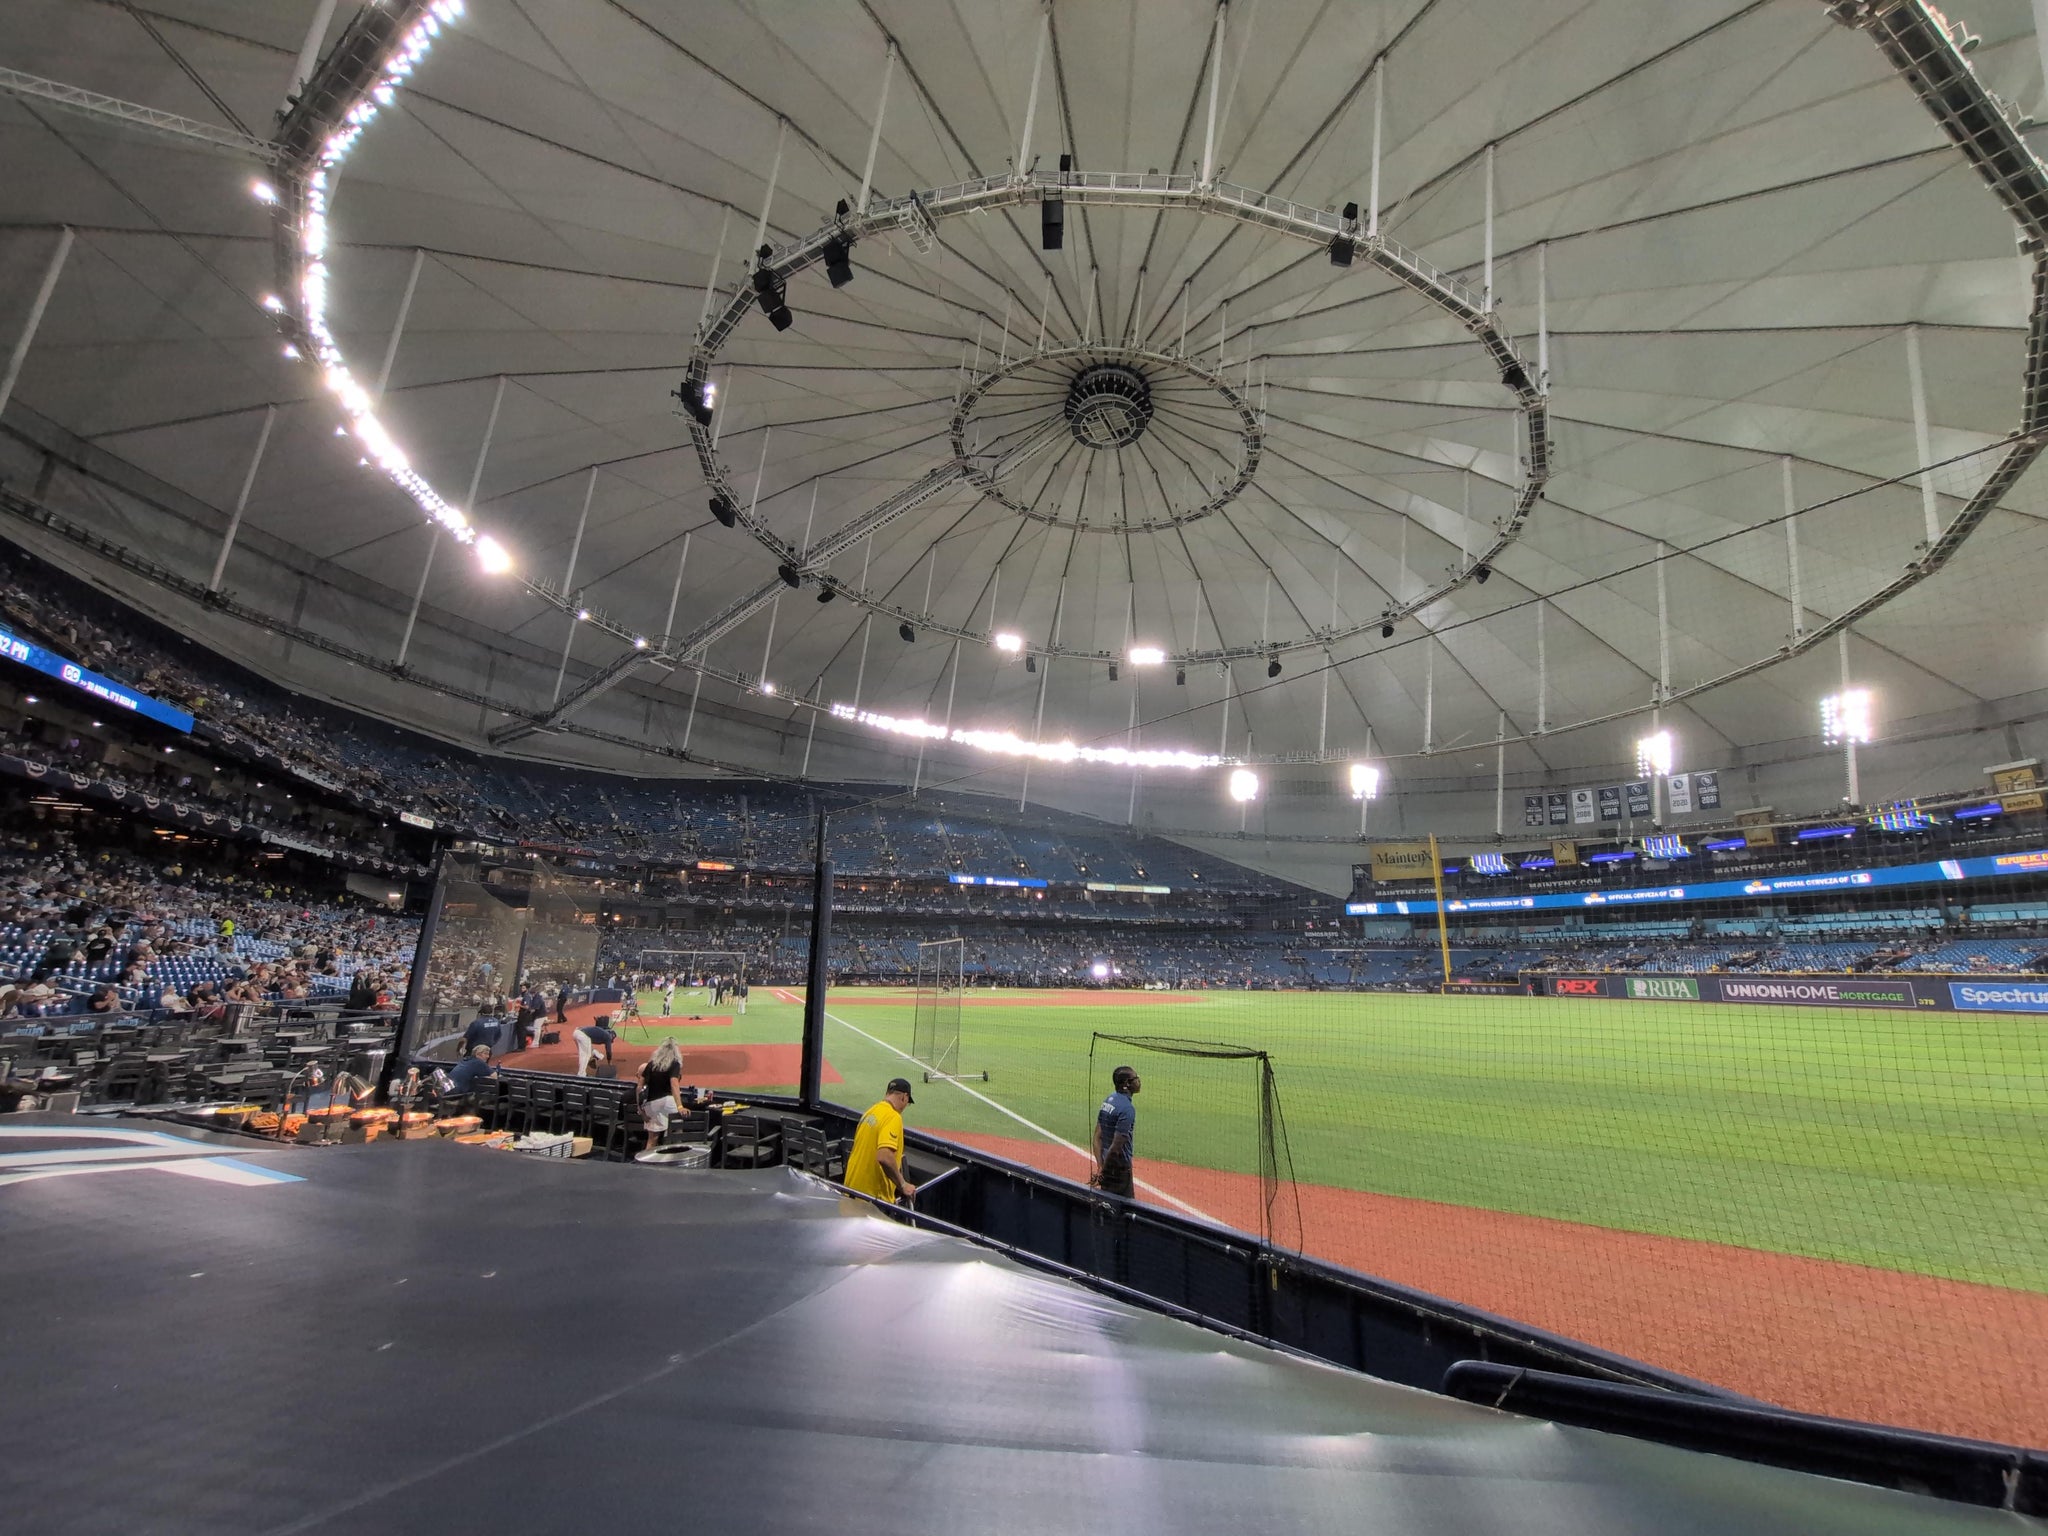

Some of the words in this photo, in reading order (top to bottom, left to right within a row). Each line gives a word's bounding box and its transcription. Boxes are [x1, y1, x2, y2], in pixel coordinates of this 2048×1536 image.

[10, 641, 30, 661] PM
[1774, 880, 1806, 889] OFFICIAL
[1805, 878, 1838, 887] CERVEZA
[1838, 876, 1849, 884] OF
[1608, 893, 1633, 901] OFFICIAL
[1649, 980, 1694, 998] RIPA
[1840, 992, 1904, 1001] MORTGAGE
[1960, 987, 2048, 1006] Spectru
